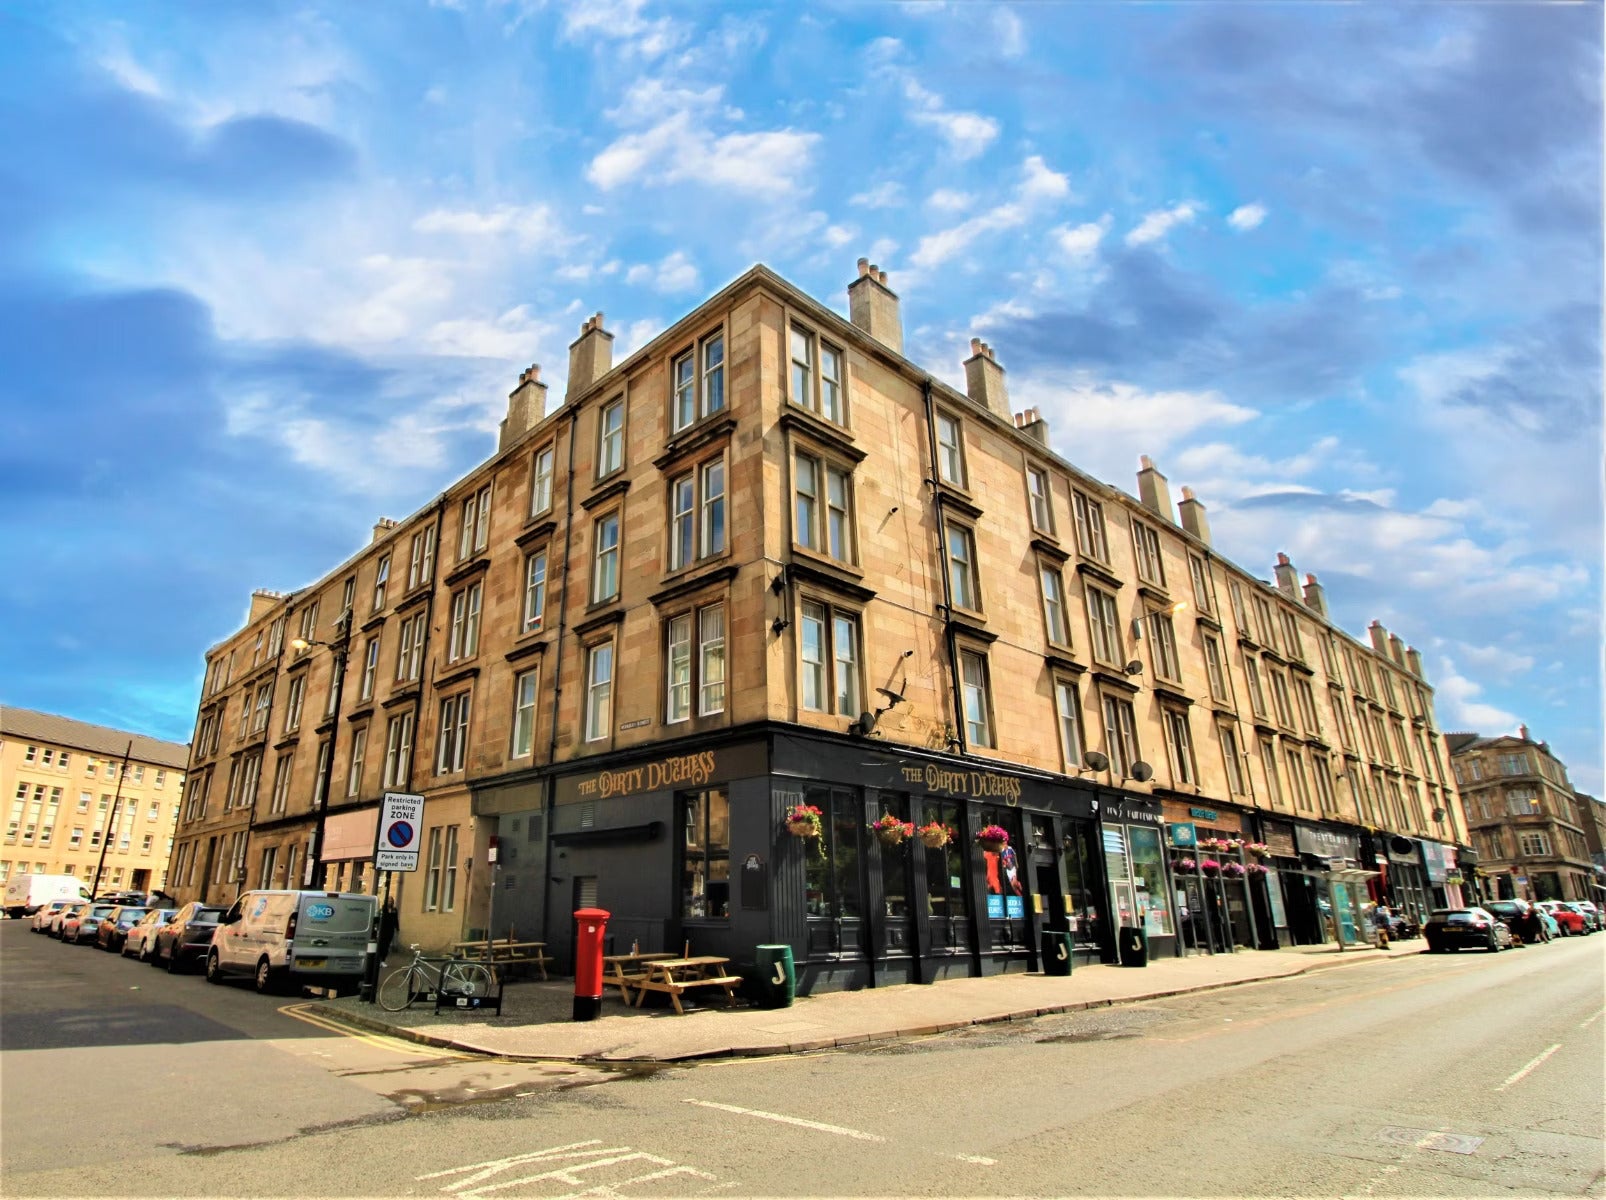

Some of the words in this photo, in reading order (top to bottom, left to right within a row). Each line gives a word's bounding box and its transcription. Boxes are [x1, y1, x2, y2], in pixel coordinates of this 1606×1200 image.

[578, 780, 597, 795] THE
[599, 768, 644, 798] DIRTY
[647, 750, 716, 790] DUCHESS
[901, 766, 923, 783] THE
[925, 763, 968, 793] DIRTY
[970, 772, 1022, 806] DUCHESS
[387, 797, 421, 805] Restricted
[391, 804, 416, 812] parking
[1057, 943, 1068, 960] J
[771, 961, 786, 986] J
